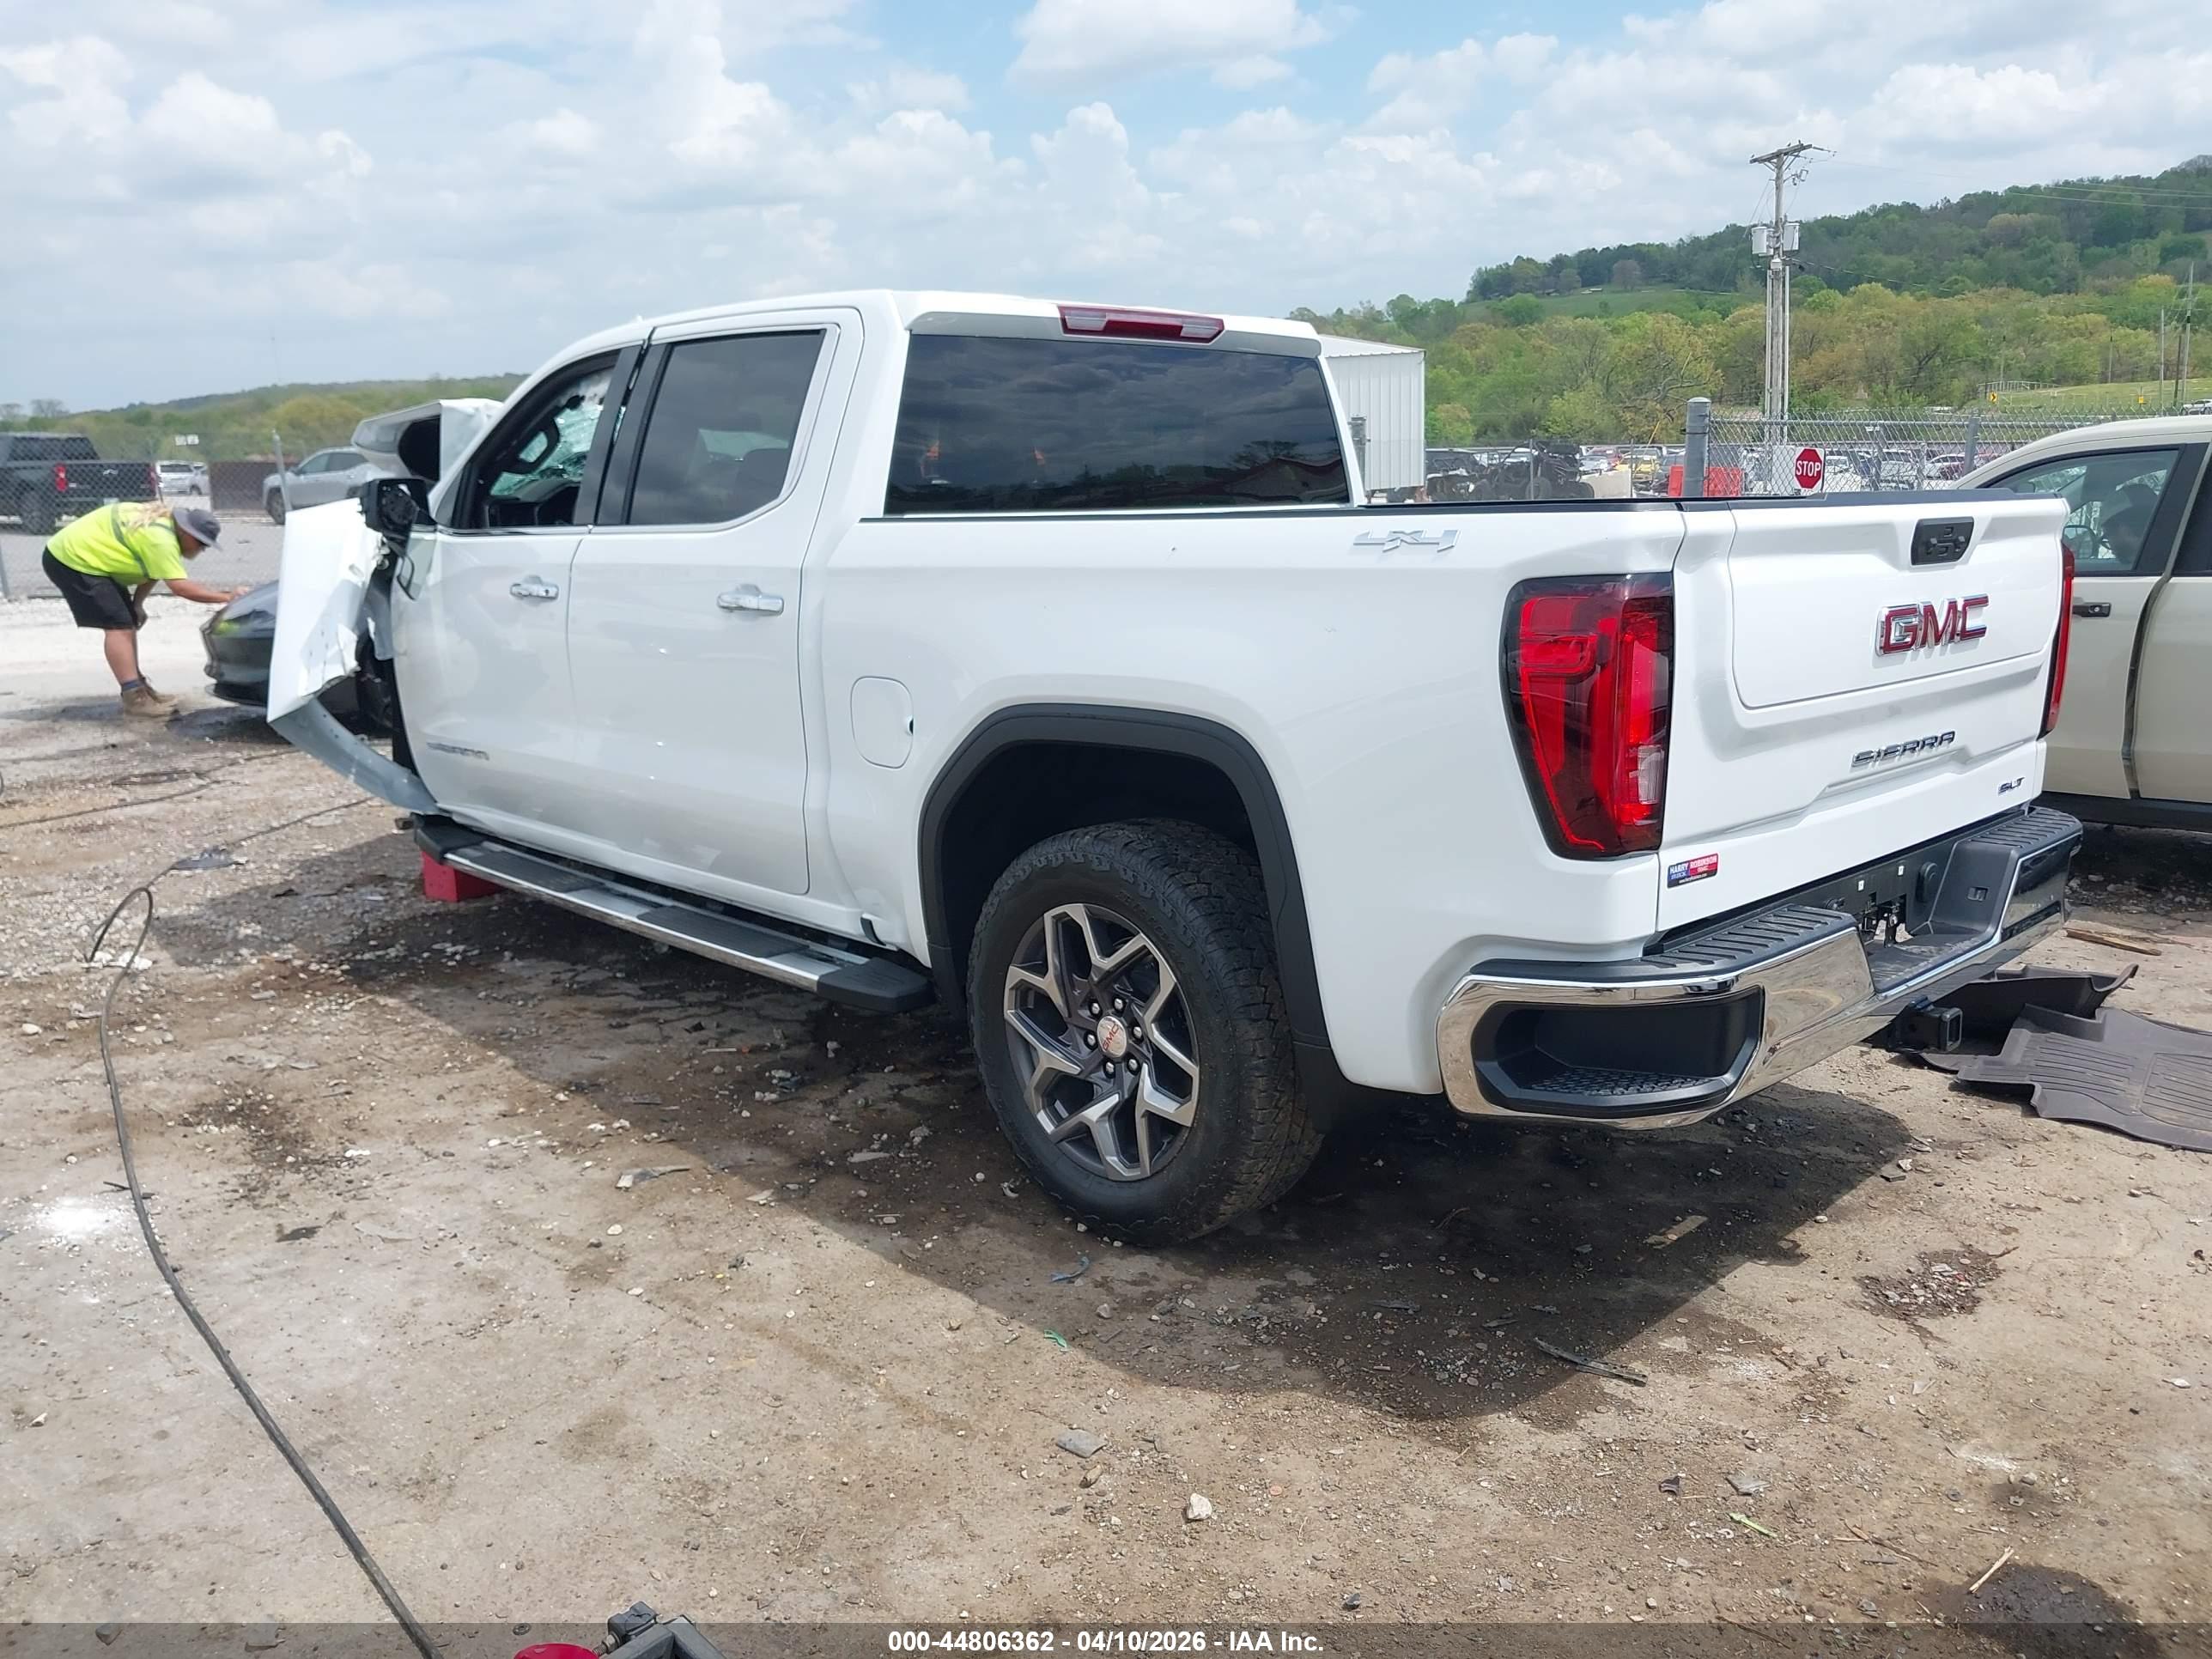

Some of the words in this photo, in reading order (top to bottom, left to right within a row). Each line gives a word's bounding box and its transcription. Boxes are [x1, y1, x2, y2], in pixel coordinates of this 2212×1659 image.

[1796, 460, 1821, 477] STOP
[1876, 592, 1990, 656] GMC
[1851, 730, 1955, 768] SIERRA
[1997, 776, 2025, 796] SLT
[1669, 862, 1689, 875] HARRY
[1103, 1024, 1120, 1051] GMC
